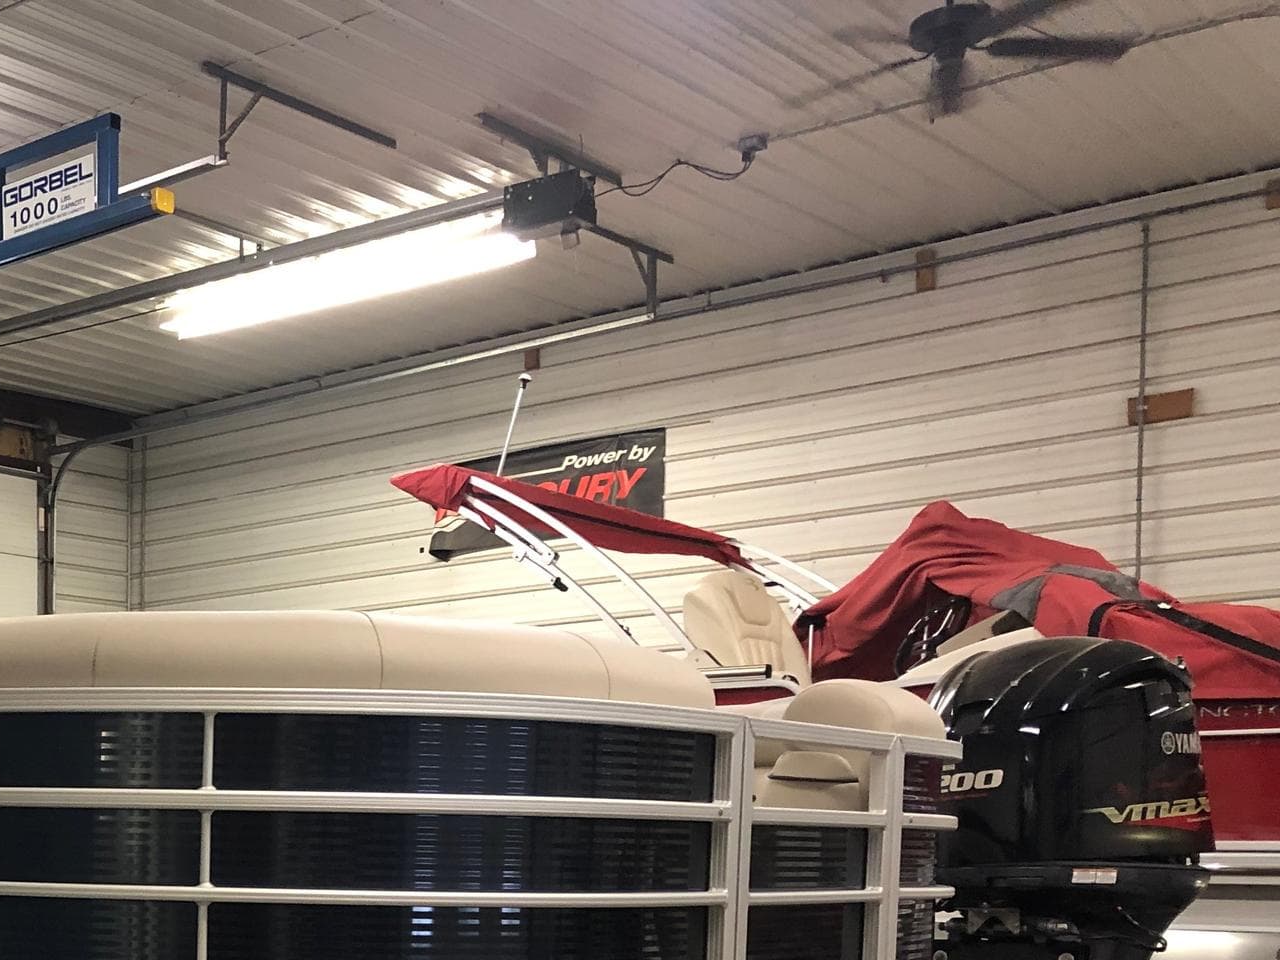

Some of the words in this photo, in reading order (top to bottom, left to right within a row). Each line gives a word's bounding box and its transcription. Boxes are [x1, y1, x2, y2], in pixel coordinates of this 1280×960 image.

[3, 162, 93, 208] GORBEL
[10, 197, 58, 228] 1000
[561, 449, 628, 469] Power
[628, 444, 656, 463] by
[535, 467, 648, 503] URY
[1175, 732, 1202, 754] YAM
